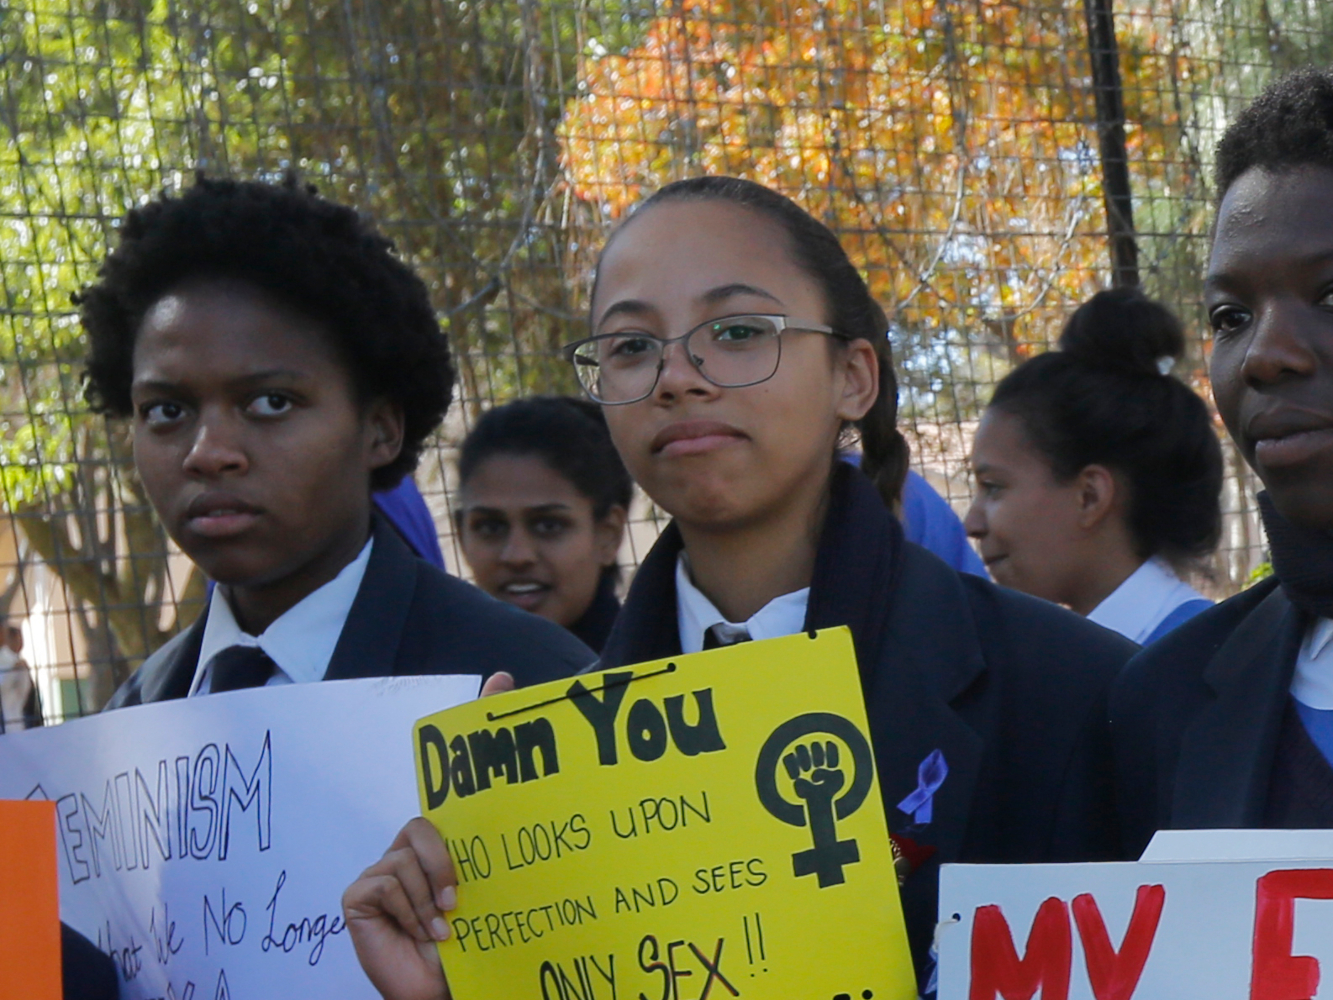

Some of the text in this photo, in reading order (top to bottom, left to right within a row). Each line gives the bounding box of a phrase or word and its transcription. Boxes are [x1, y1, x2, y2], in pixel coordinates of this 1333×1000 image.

[418, 671, 727, 811] Damn You
[24, 729, 272, 885] EMINISM
[445, 790, 711, 886] HO LOOKS UPON
[99, 918, 143, 983] hat
[261, 869, 346, 967] Longe
[452, 857, 769, 953] PERFECTION AND SEES
